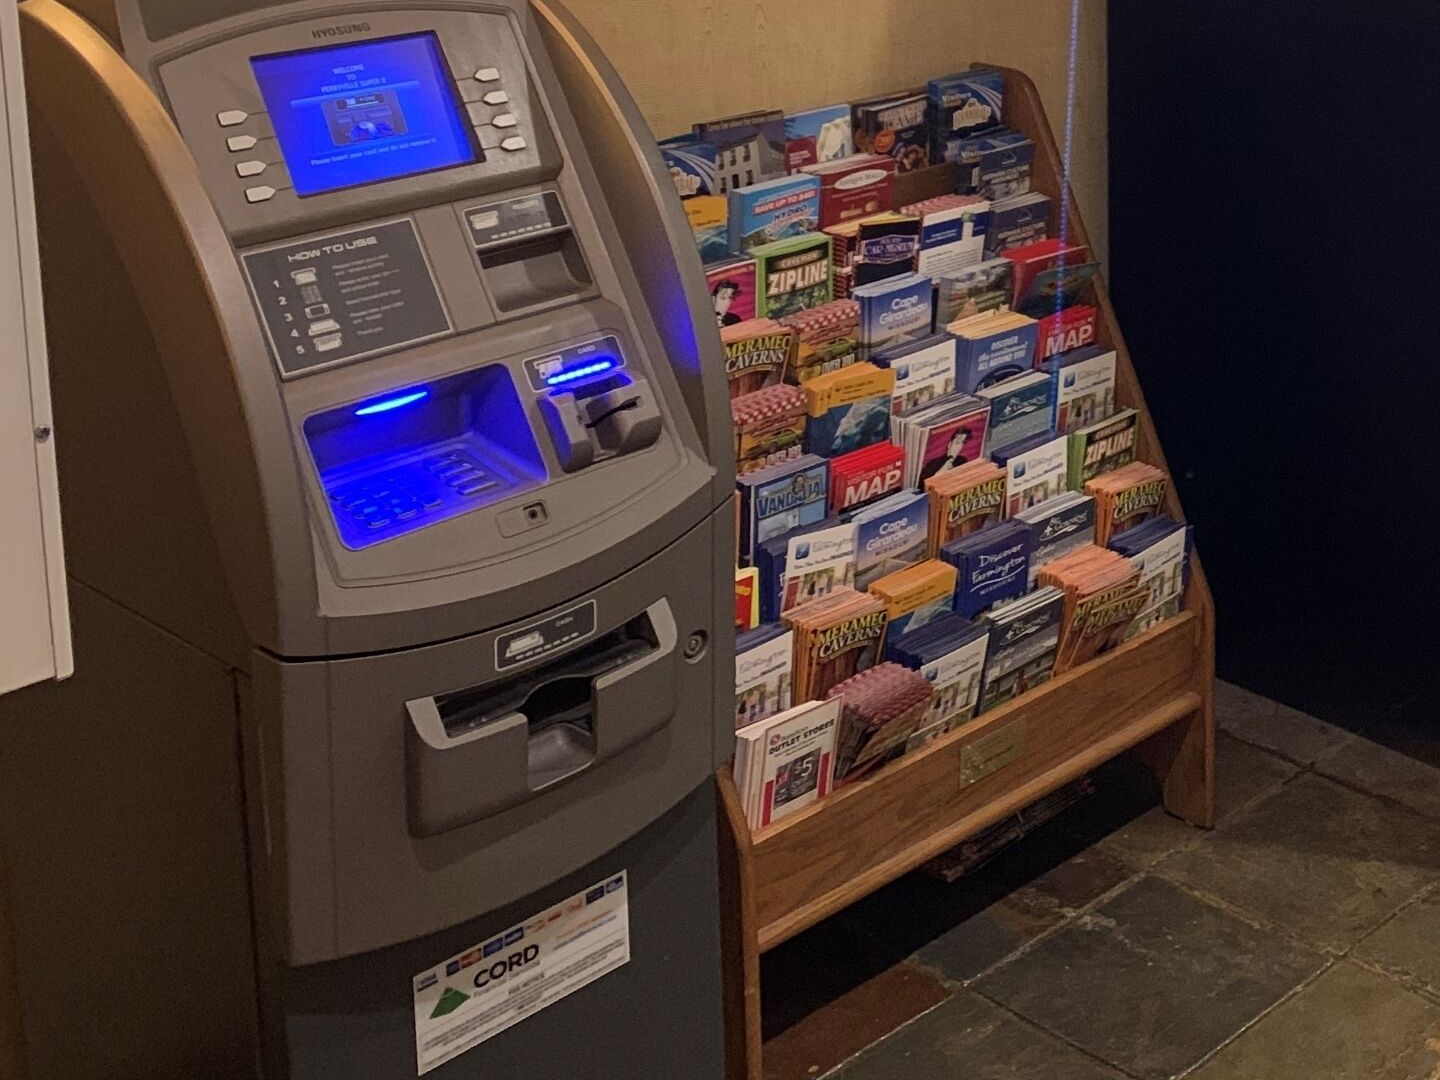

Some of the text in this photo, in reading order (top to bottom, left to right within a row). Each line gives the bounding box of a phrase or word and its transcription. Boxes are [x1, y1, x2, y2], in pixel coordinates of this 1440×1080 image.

[312, 23, 371, 40] HYOSUNG
[288, 236, 378, 262] HOW TO USE
[768, 260, 829, 295] ZIPLINE
[879, 302, 928, 325] Girardeau
[891, 294, 919, 311] Cape
[726, 335, 791, 360] MERAMEC
[1045, 325, 1093, 358] MAP
[726, 349, 785, 373] CAVERNS
[1085, 428, 1135, 464] ZIPLINE
[844, 470, 901, 508] MAP
[949, 478, 1006, 510] MERAMEC
[1114, 480, 1166, 507] MERAMEC
[949, 492, 1001, 522] CAVERNS
[1113, 494, 1160, 519] CAVERNS
[866, 524, 918, 552] Girardeau
[879, 517, 908, 536] Cape
[979, 544, 1024, 567] Discover
[972, 556, 1026, 584] Farmington
[818, 611, 888, 647] MERAMEC
[819, 625, 882, 658] CAVERNS
[769, 734, 802, 756] OUTLET
[803, 719, 835, 739] STORES
[473, 944, 540, 988] CORD
